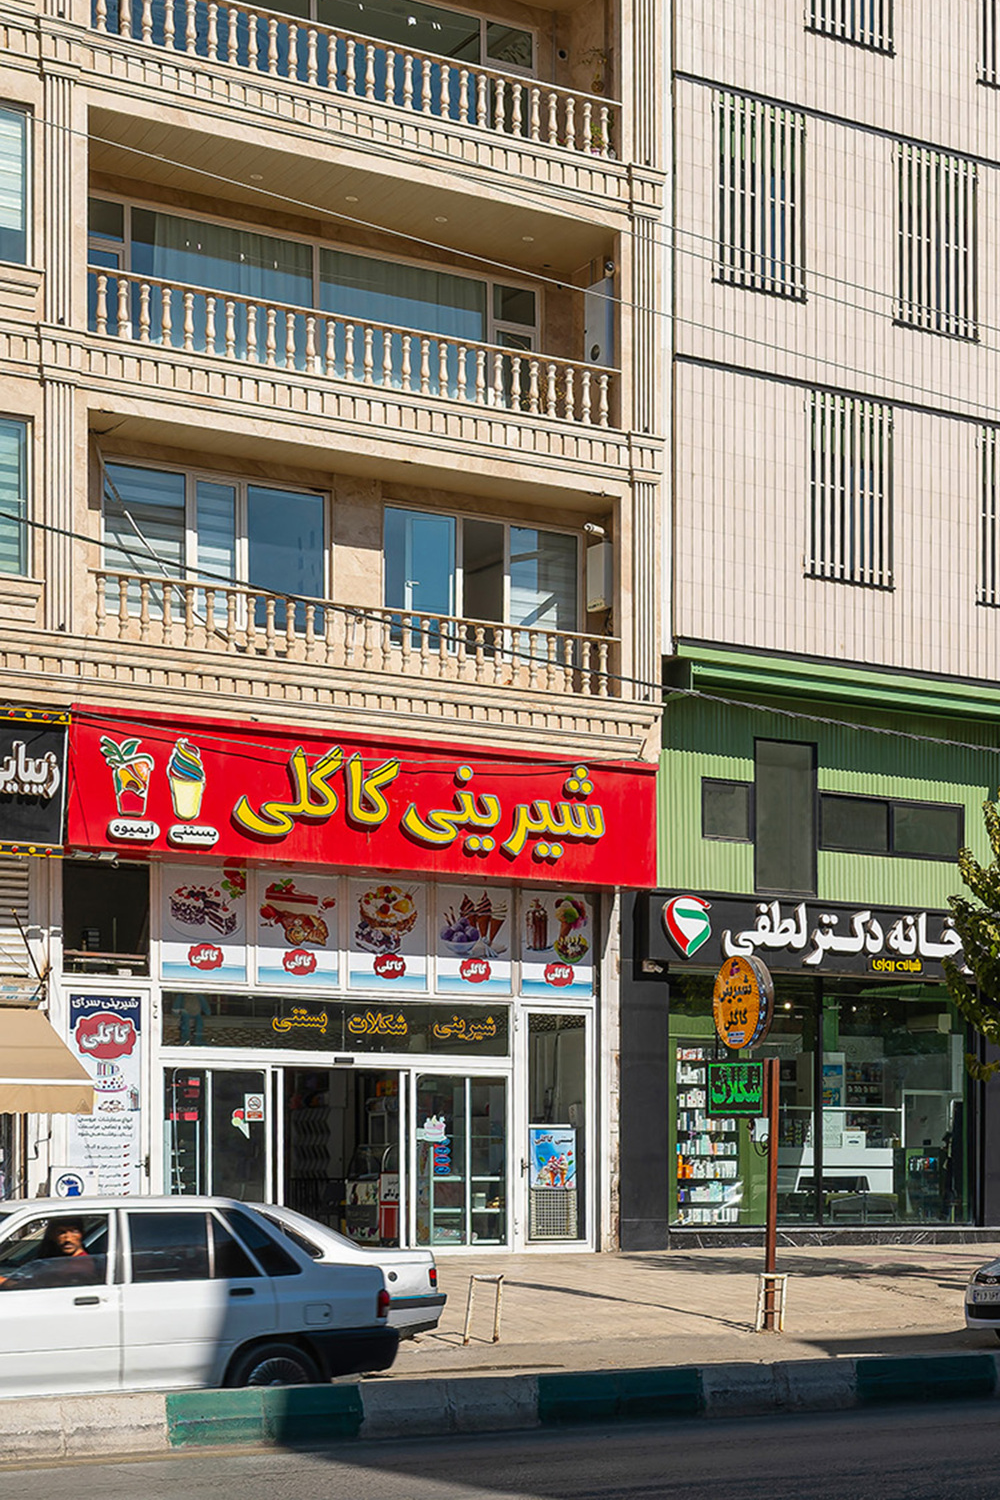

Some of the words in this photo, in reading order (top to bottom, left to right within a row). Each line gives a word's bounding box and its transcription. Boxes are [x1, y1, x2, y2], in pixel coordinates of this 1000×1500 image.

[401, 765, 606, 857] شیرینی
[171, 825, 218, 841] بستنی
[722, 900, 808, 958] لطفی
[802, 910, 884, 966] دکتر
[872, 958, 895, 972] روزی
[896, 958, 922, 972] شبانه
[718, 974, 753, 1003] شیرینی
[72, 997, 100, 1008] سرای
[101, 998, 139, 1010] شیرینی
[272, 1007, 328, 1034] بستنی
[347, 1011, 408, 1036] شکلات
[433, 1014, 497, 1041] شیرینی
[711, 1066, 762, 1104] شکلات
